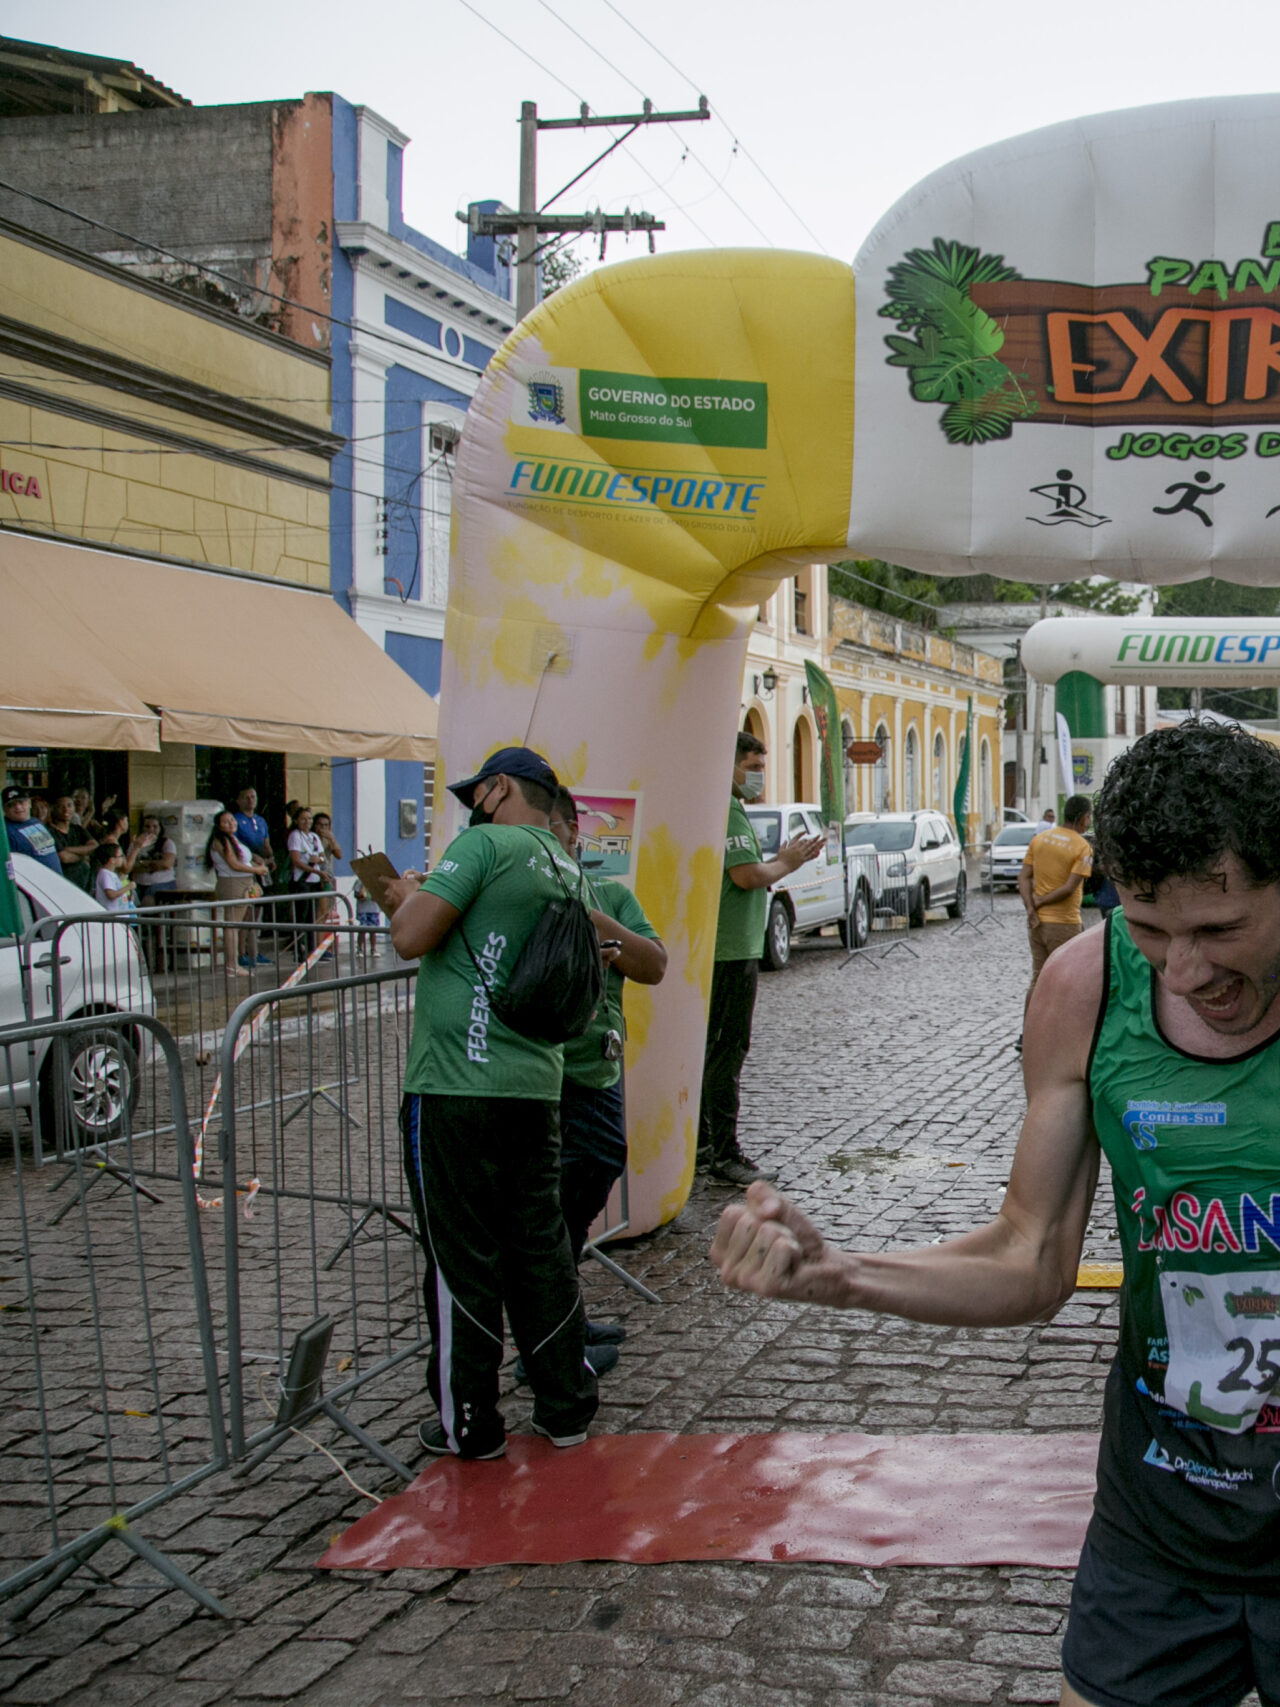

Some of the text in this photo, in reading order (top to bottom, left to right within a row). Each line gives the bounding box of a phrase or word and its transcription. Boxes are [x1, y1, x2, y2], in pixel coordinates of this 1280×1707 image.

[588, 387, 756, 412] GOVERNO DO ESTADO
[590, 410, 692, 428] Mato Grosso do Sul
[1106, 432, 1247, 460] JOGOS
[509, 461, 766, 514] FUNDESPORTE
[726, 836, 751, 851] FIE
[467, 931, 507, 1063] FEDERAÇÕES
[1139, 1112, 1220, 1124] Contas-Sul
